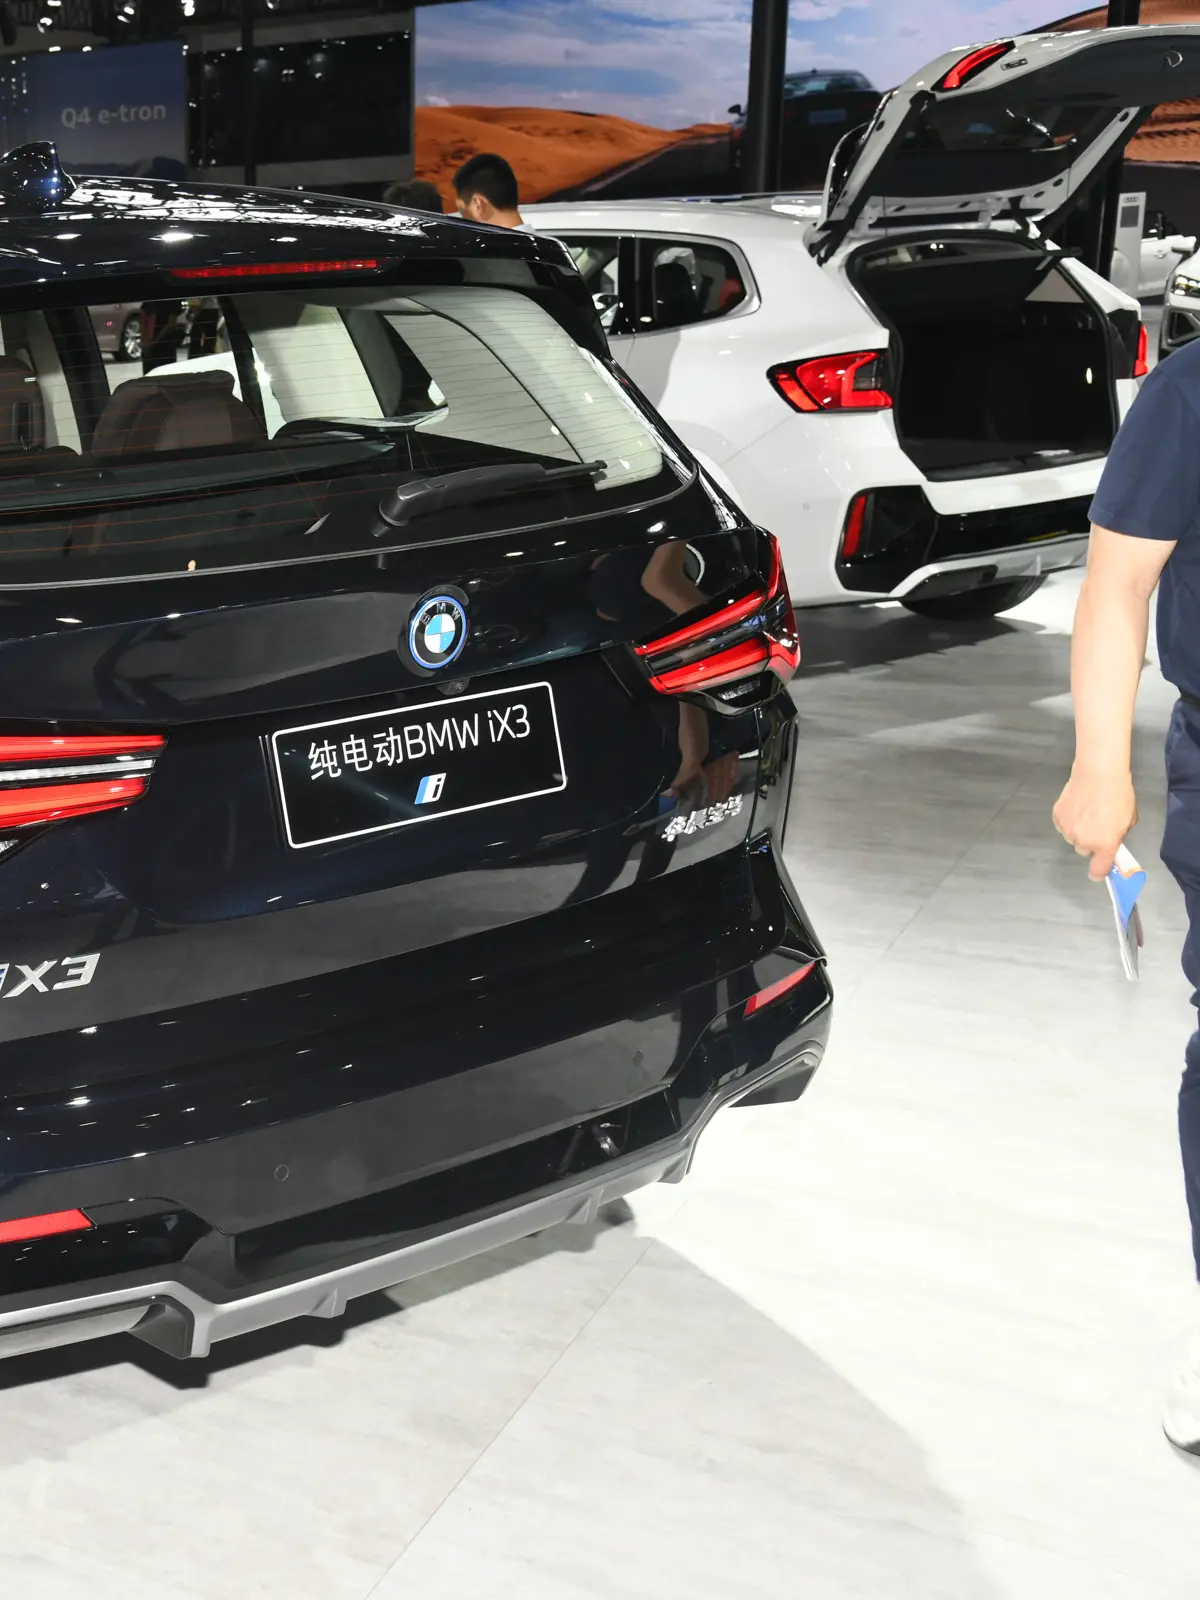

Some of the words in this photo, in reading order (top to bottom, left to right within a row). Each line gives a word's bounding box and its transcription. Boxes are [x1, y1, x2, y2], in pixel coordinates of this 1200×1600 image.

[61, 107, 92, 129] Q4
[98, 104, 166, 124] e-tron
[487, 704, 531, 743] iX3
